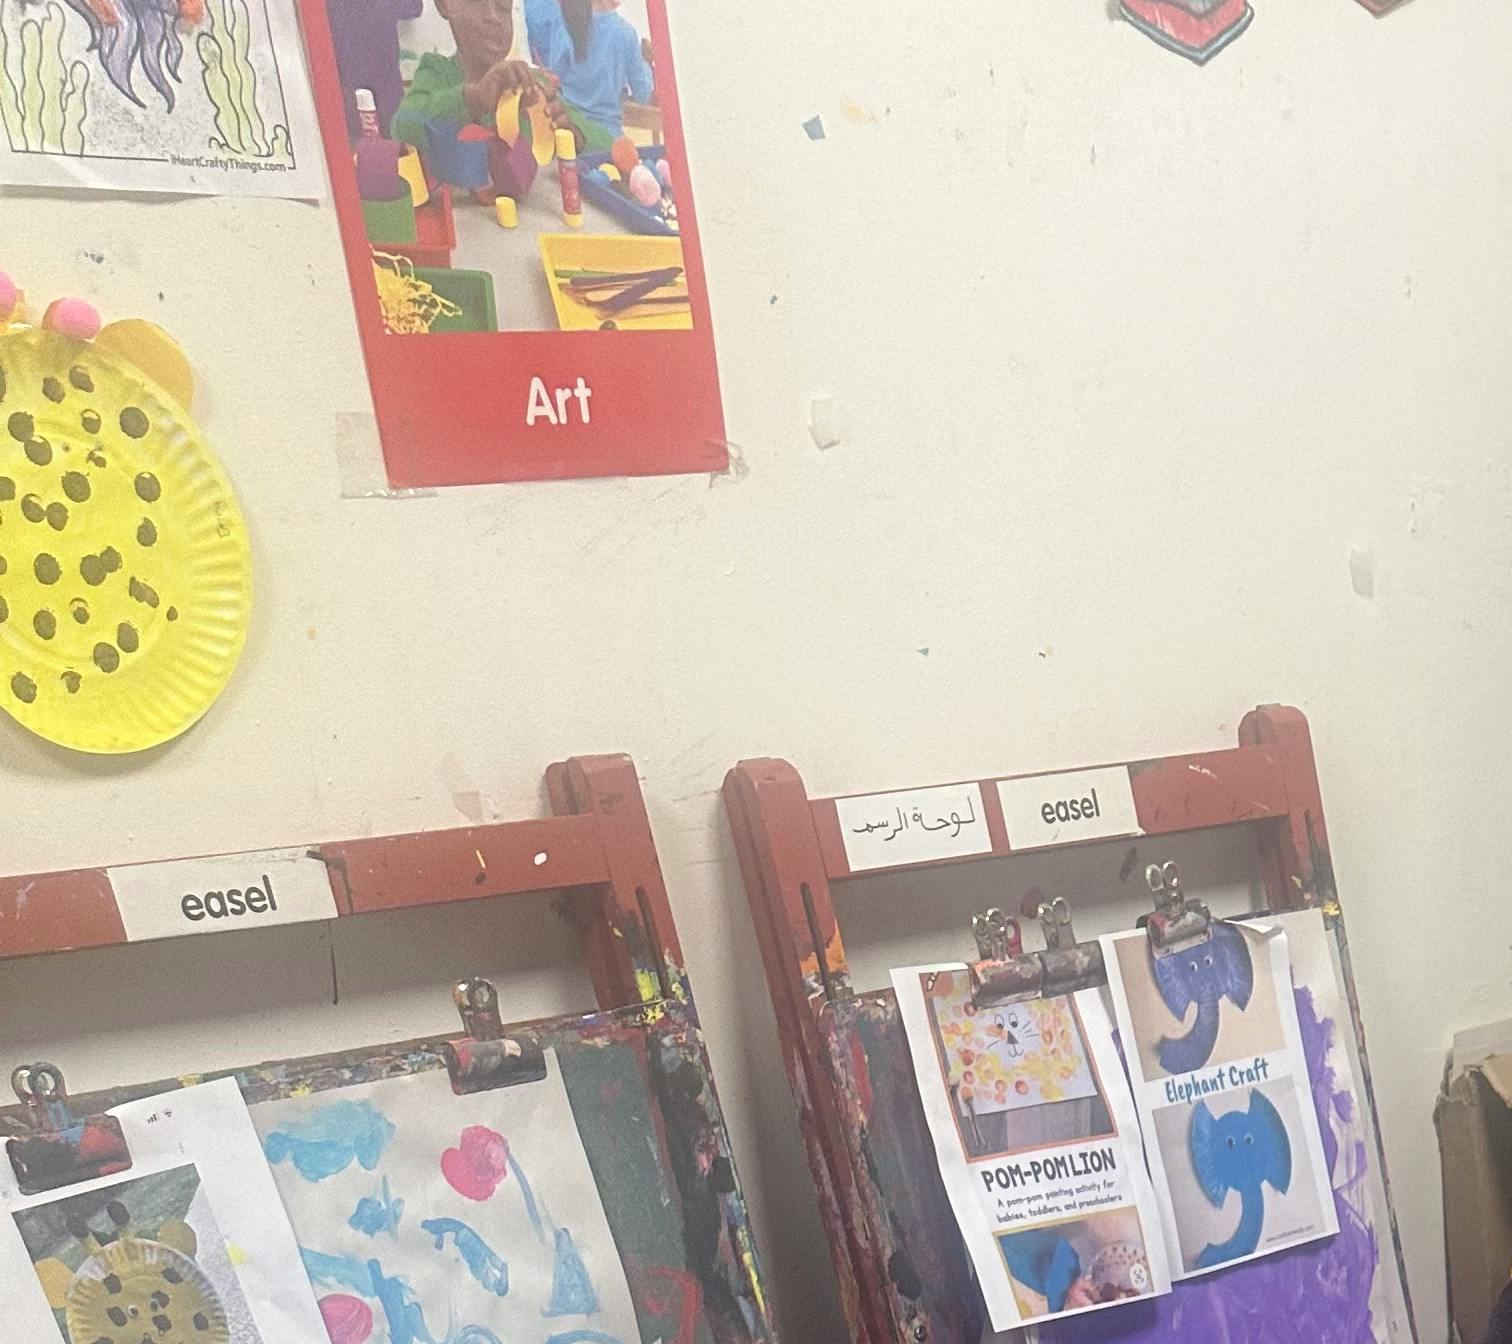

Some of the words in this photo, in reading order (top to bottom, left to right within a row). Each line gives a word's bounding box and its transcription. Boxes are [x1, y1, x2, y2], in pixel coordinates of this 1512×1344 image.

[170, 154, 287, 173] iHeartCraftyThings.com
[526, 376, 592, 426] Art
[851, 806, 909, 842] الرسم
[911, 795, 976, 838] لوحة
[1040, 788, 1101, 825] easel
[180, 873, 278, 922] easel
[1164, 1068, 1226, 1105] Elephant
[1228, 1057, 1269, 1086] Craft
[981, 1157, 1070, 1193] POM-POM
[1068, 1147, 1117, 1177] LION
[1063, 1200, 1078, 1211] and
[1078, 1193, 1123, 1210] preschoolers
